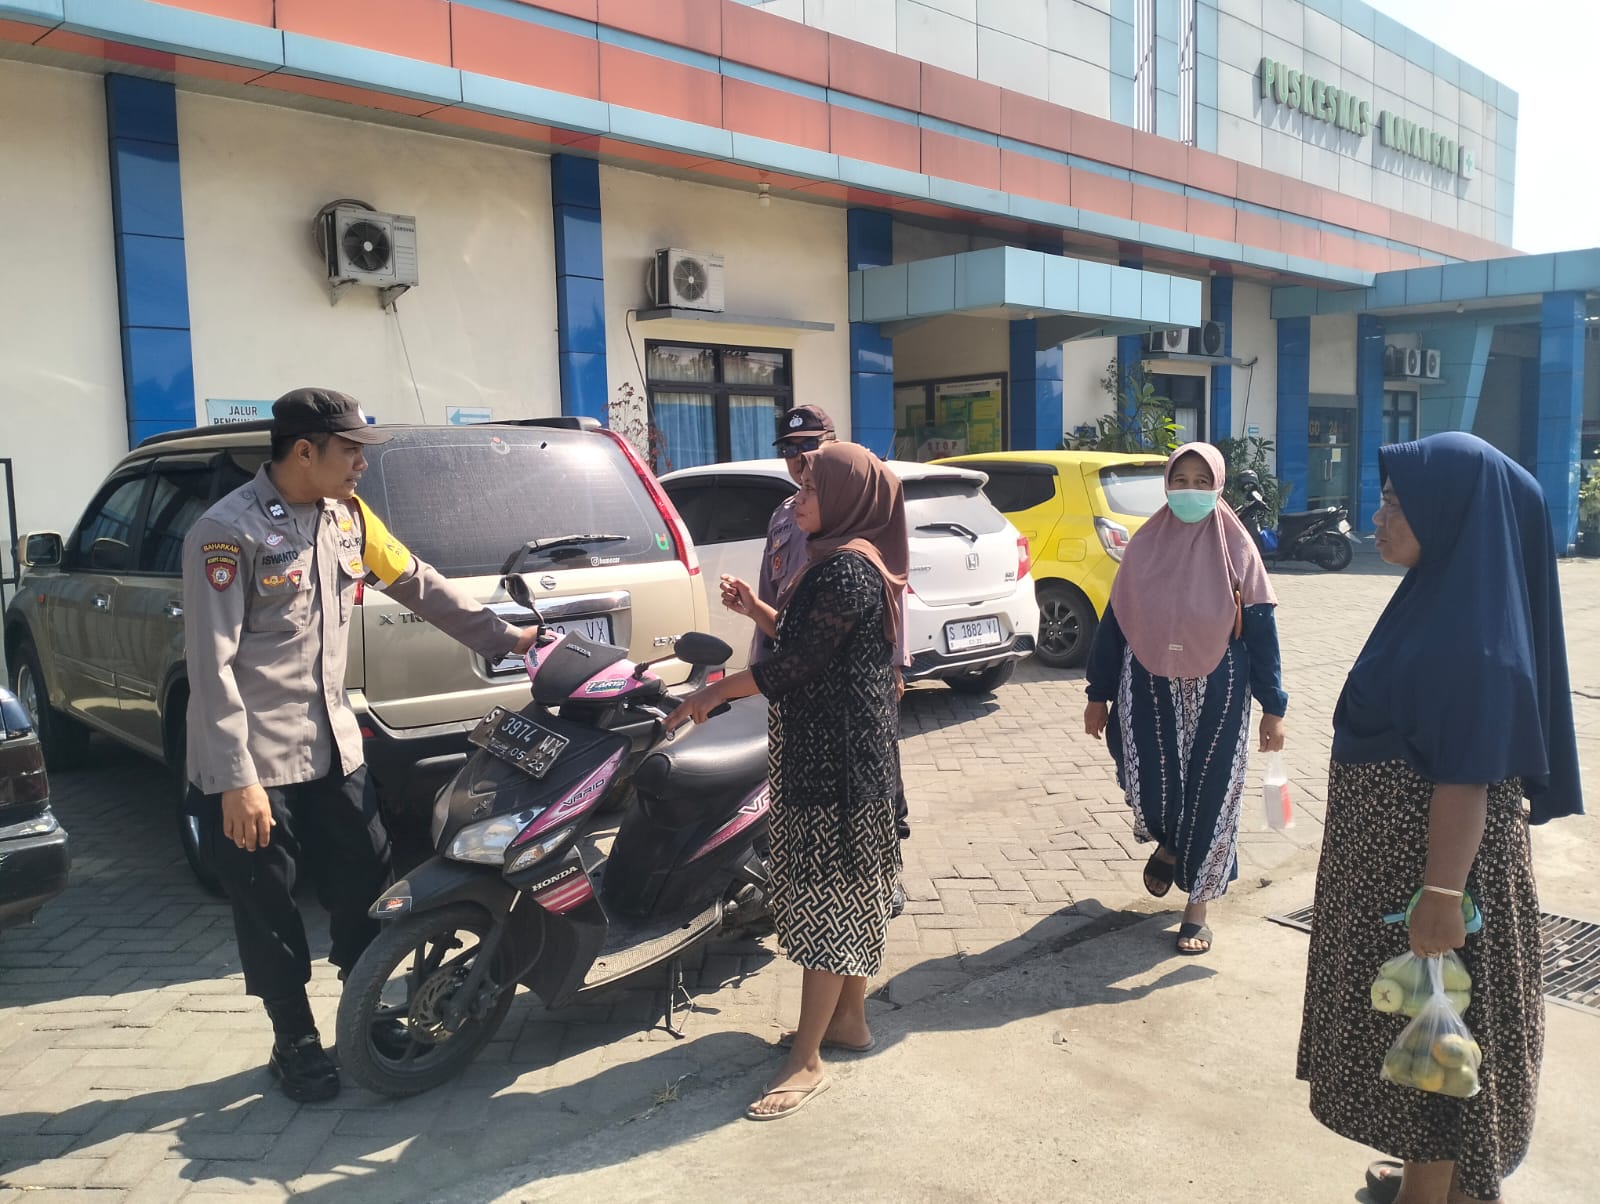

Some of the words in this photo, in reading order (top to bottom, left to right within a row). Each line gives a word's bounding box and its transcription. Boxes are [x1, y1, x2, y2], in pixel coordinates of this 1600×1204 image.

[1260, 56, 1370, 137] PUSKESMAS
[229, 405, 258, 416] JALUR
[203, 543, 240, 554] BAHARKAM
[262, 551, 298, 566] ISWANTO
[949, 626, 956, 640] S
[962, 622, 983, 639] 1882
[485, 708, 501, 723] S
[501, 716, 539, 743] 3974
[562, 778, 605, 806] VARIO
[531, 865, 579, 893] HONDA
